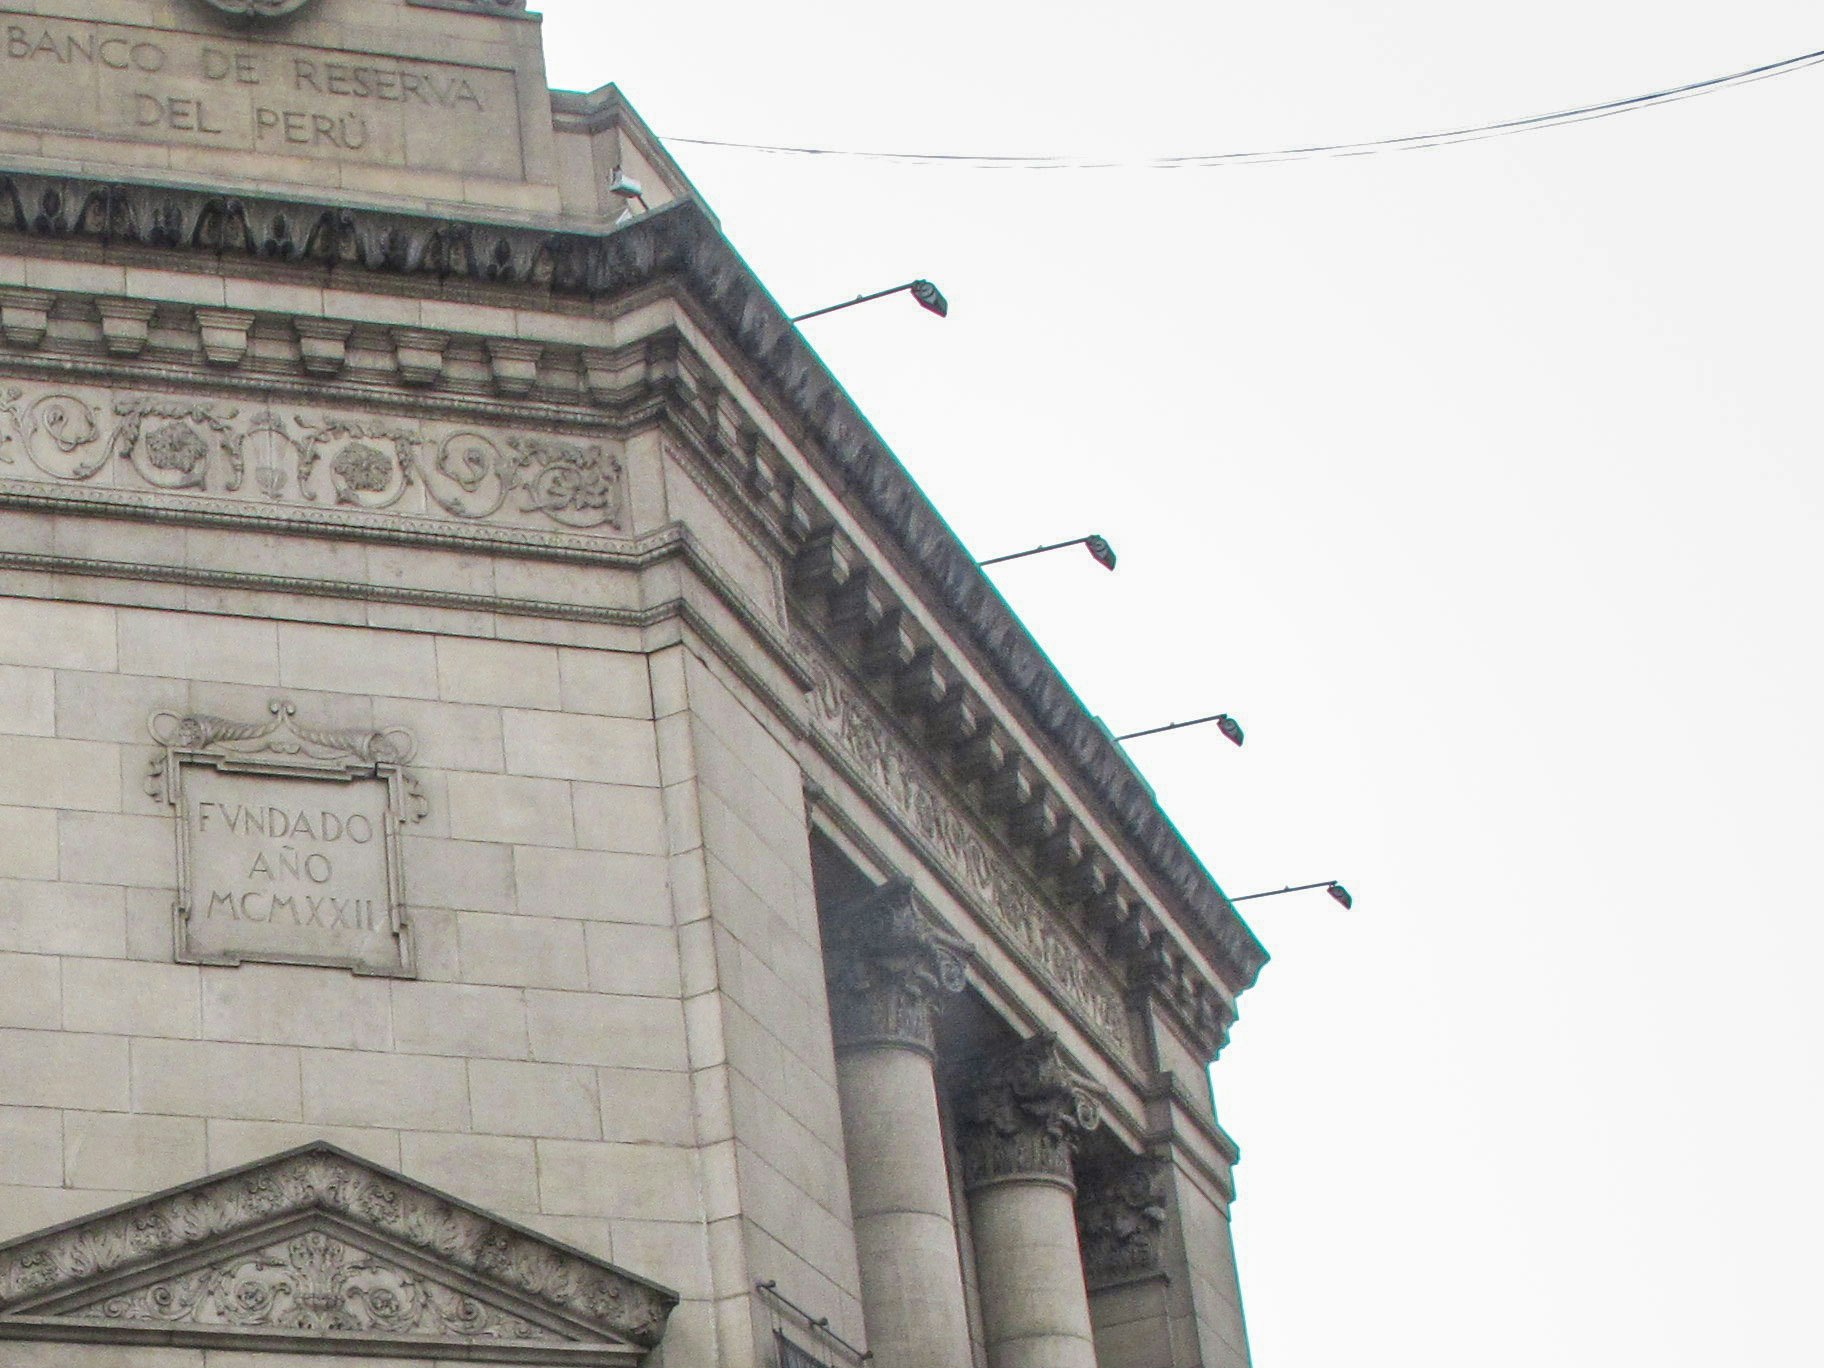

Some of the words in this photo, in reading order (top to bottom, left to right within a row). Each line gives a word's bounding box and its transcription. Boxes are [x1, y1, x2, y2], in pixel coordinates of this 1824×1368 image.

[5, 25, 168, 74] BANCO
[199, 46, 261, 86] DE
[292, 57, 487, 112] RESERVA
[133, 92, 225, 135] DEL
[198, 802, 374, 844] FVNDADO
[248, 845, 333, 883] AÑO
